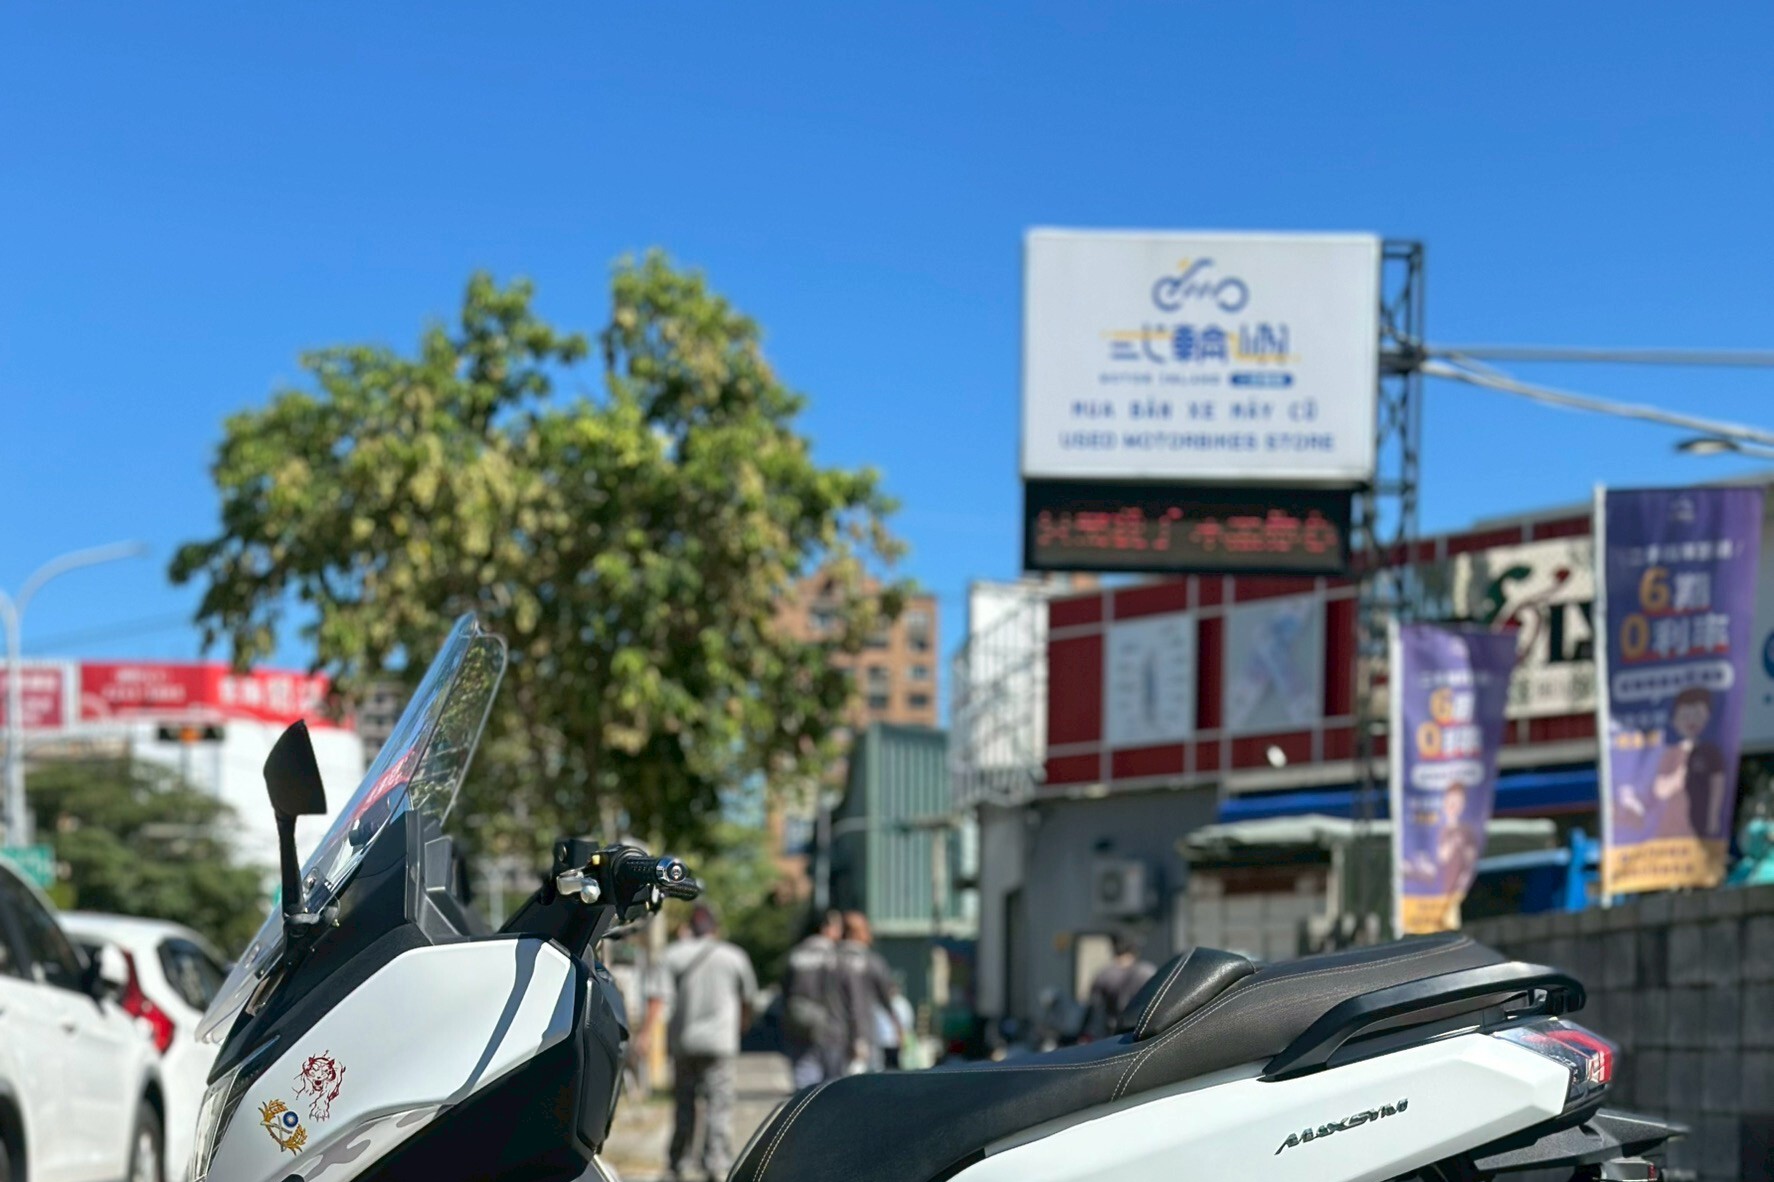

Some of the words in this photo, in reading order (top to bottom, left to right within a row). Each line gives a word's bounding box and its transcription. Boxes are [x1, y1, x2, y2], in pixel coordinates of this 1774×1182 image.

[1060, 431, 1115, 450] USED
[1123, 431, 1258, 450] MOTORBIKES
[1265, 431, 1335, 450] STORE
